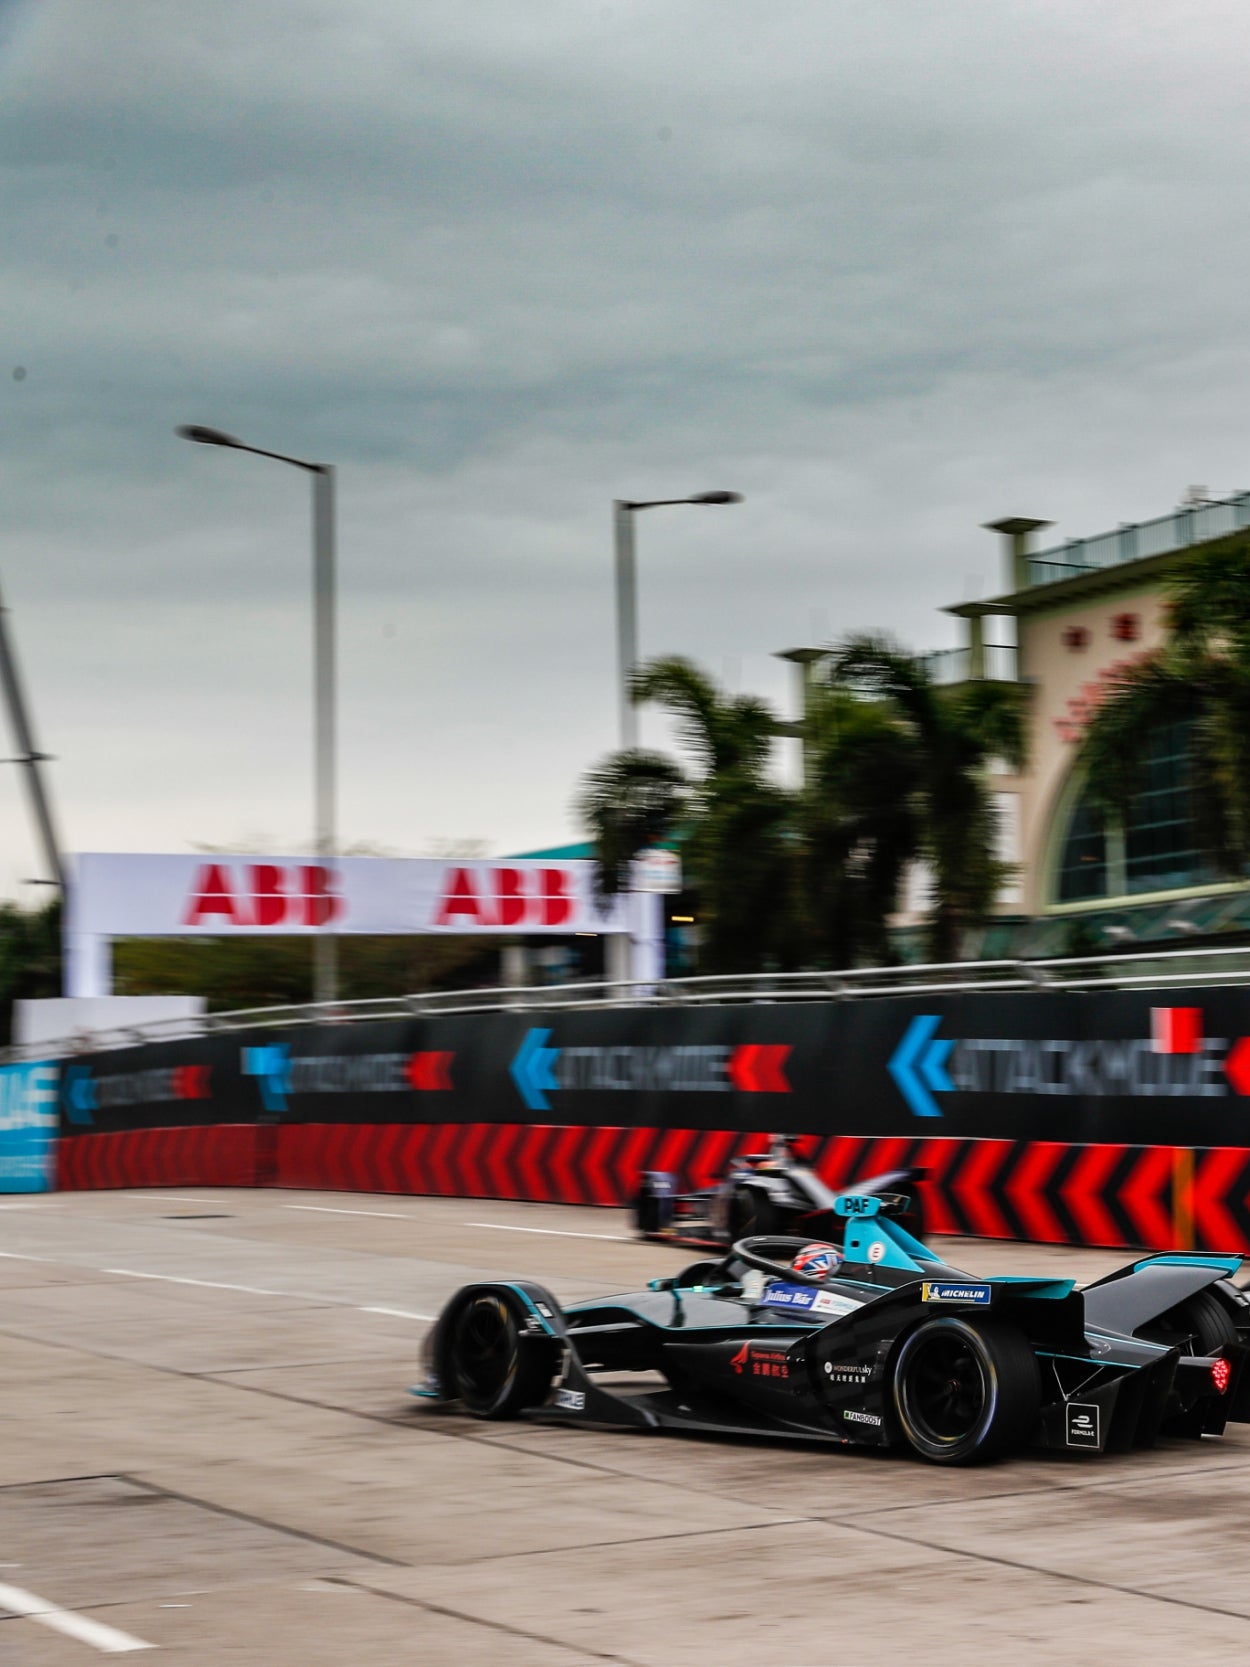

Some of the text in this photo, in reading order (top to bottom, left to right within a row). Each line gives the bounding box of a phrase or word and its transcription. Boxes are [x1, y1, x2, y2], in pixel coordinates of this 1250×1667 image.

[181, 864, 347, 927] ABB
[430, 867, 577, 926] ABB
[844, 1197, 870, 1214] PAF
[763, 1289, 792, 1303] Julius
[792, 1292, 813, 1305] Bär
[941, 1285, 985, 1299] MICHELIN
[849, 1411, 881, 1426] FANBOOST
